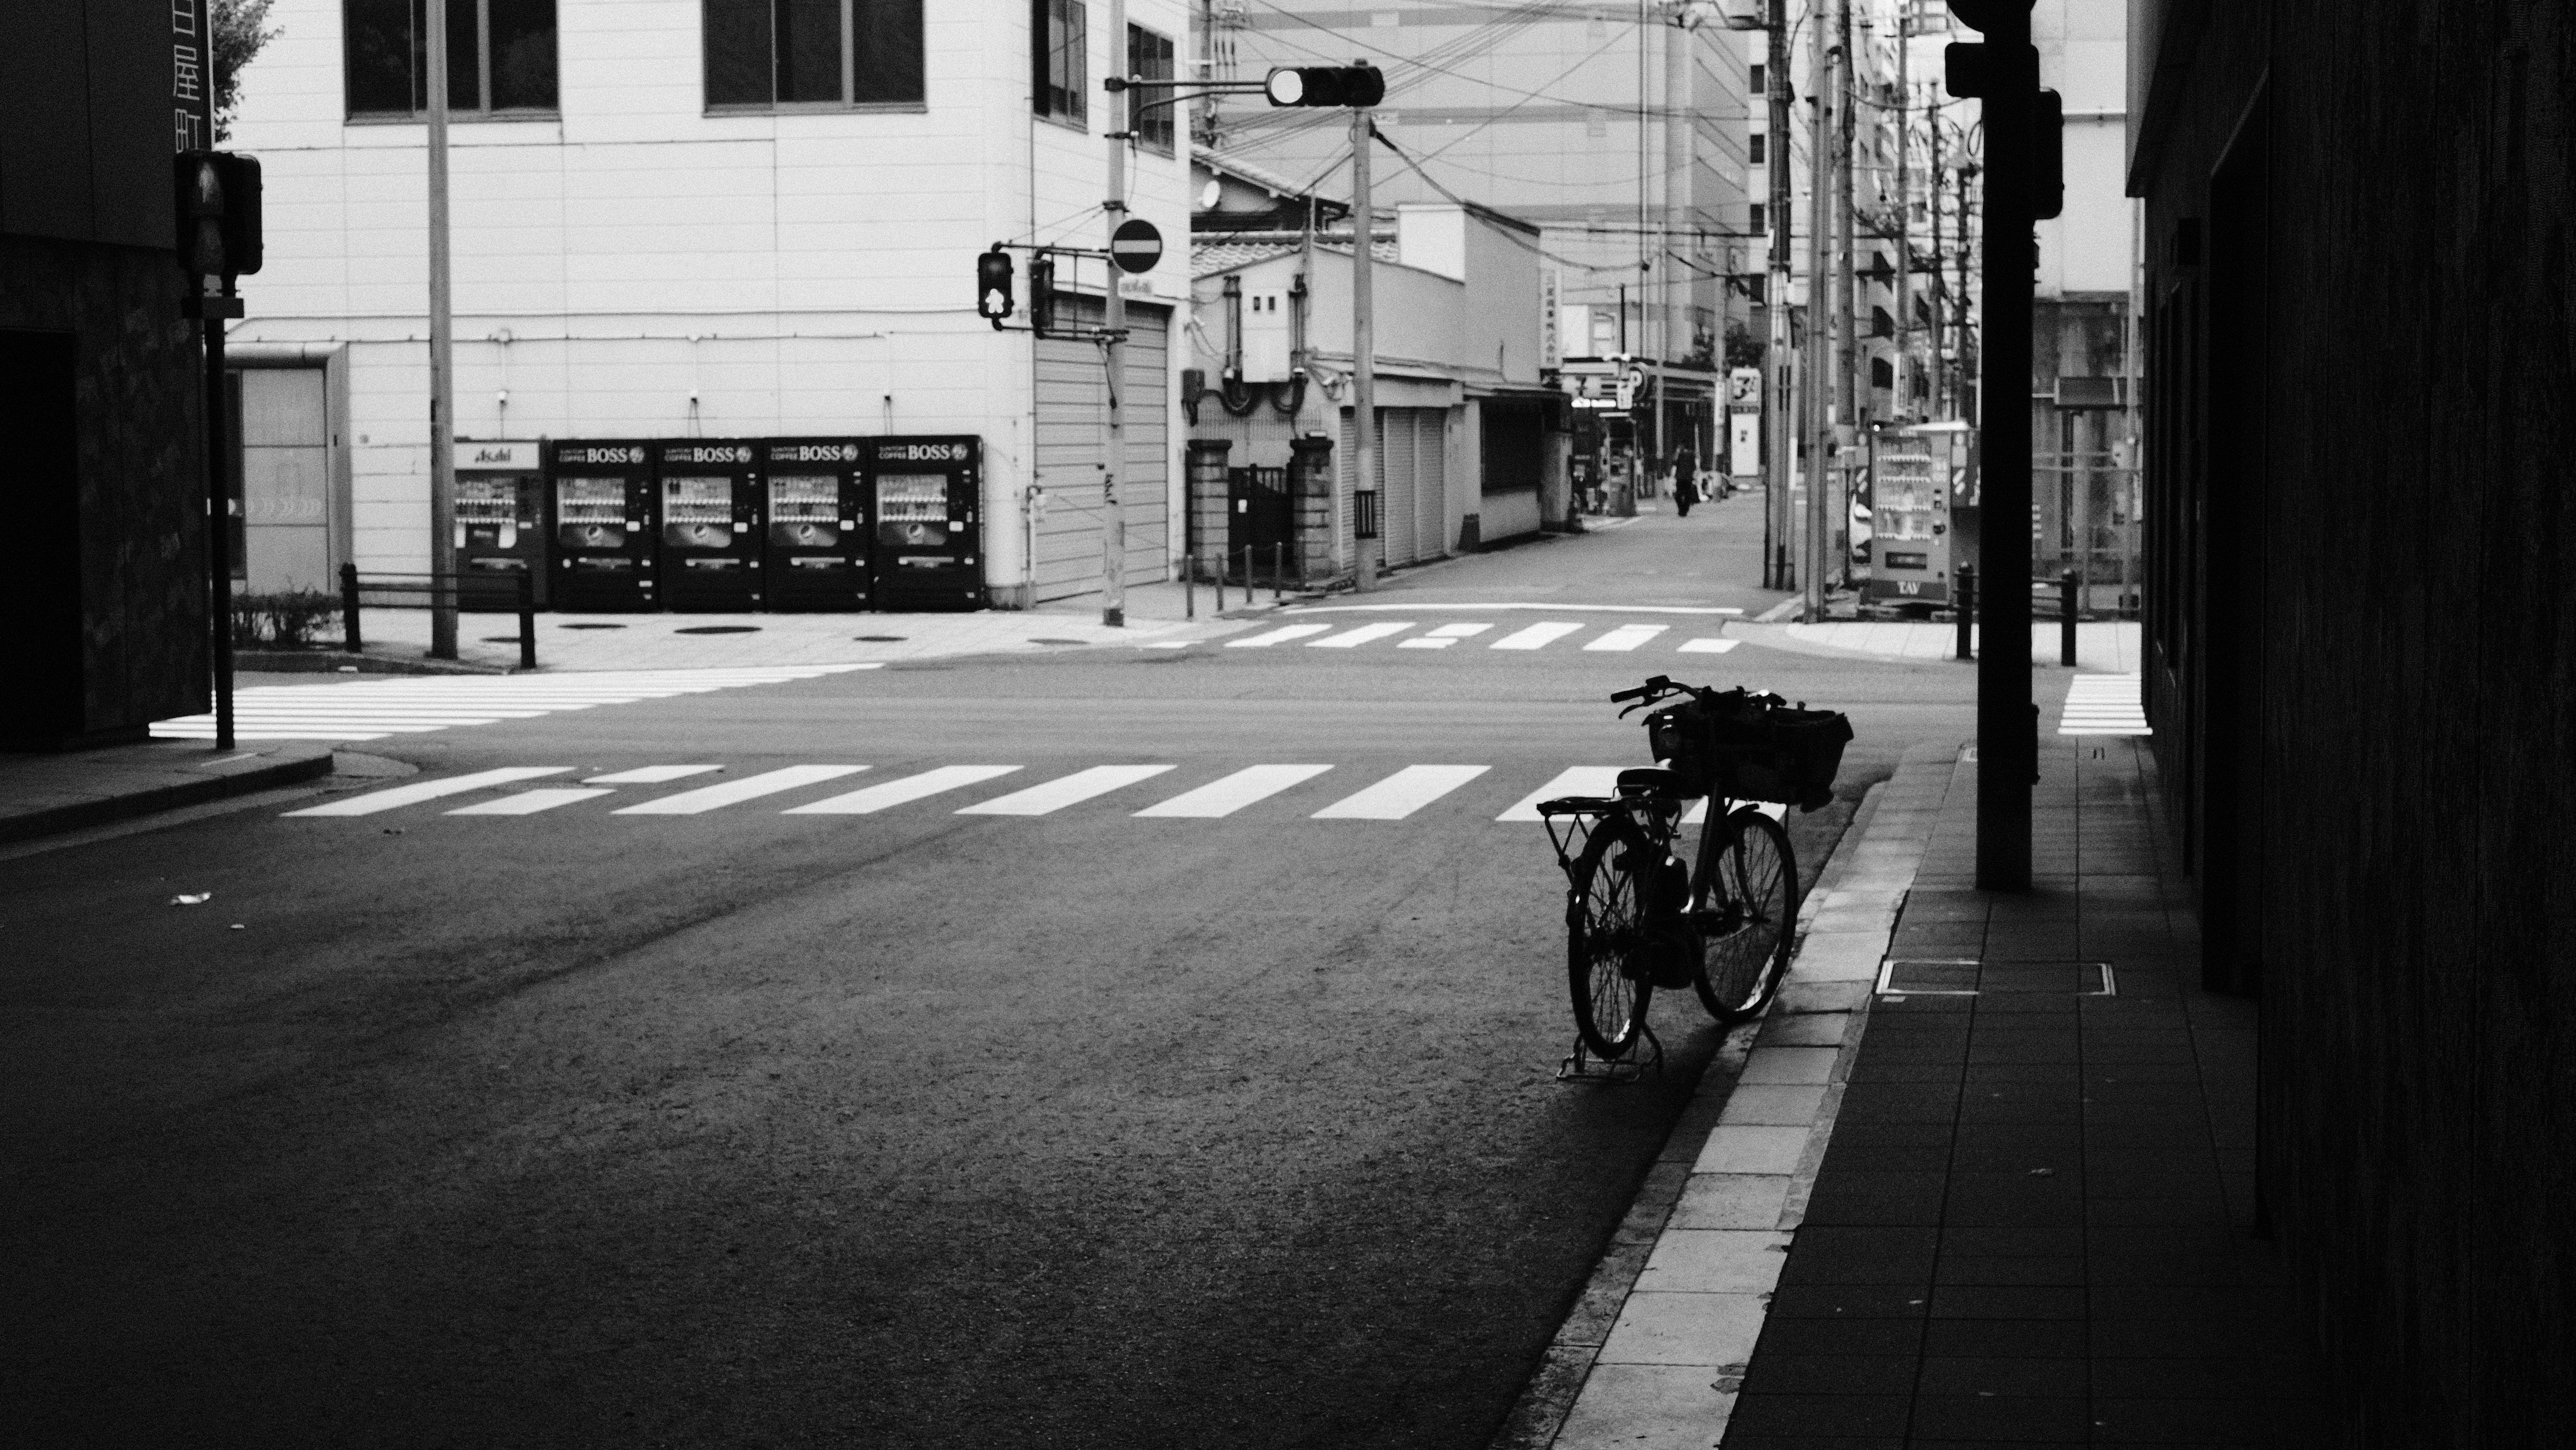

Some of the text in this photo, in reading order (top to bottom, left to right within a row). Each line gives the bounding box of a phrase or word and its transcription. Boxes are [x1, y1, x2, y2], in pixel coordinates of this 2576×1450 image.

[475, 449, 511, 463] Asahi
[587, 448, 628, 462] BOSS
[694, 447, 734, 462] BOSS
[800, 445, 841, 461] BOSS
[908, 445, 950, 460] BOSS
